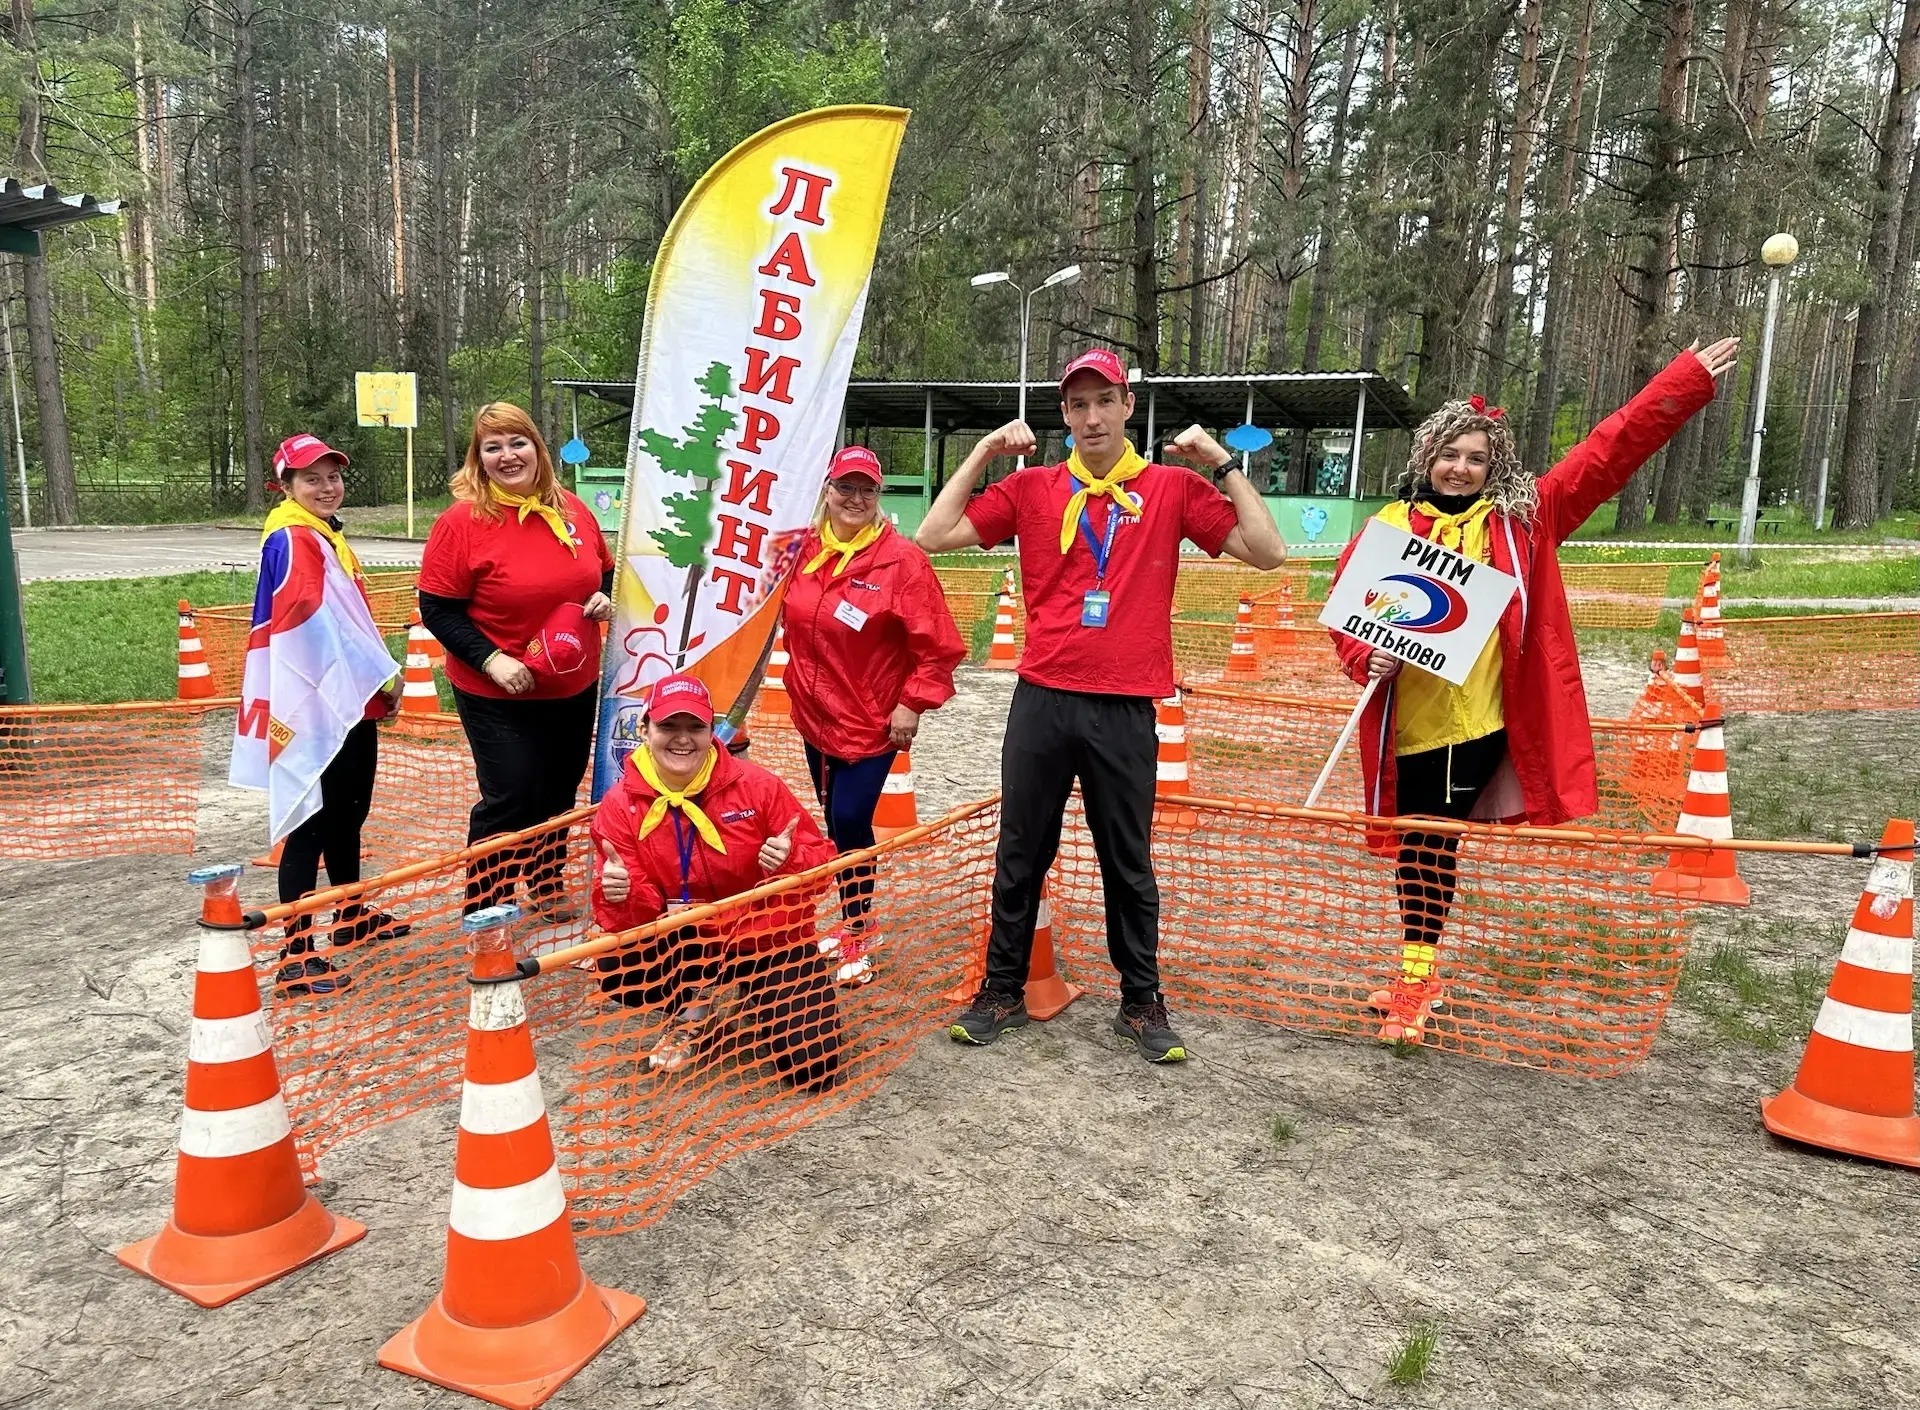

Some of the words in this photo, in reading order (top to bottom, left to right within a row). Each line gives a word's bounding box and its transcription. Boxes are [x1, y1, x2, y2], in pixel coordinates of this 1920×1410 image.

[712, 166, 832, 616] ЛАБИРИНТ
[1401, 538, 1475, 587] РИТМ
[1342, 614, 1447, 671] ДЯТЬКОВО
